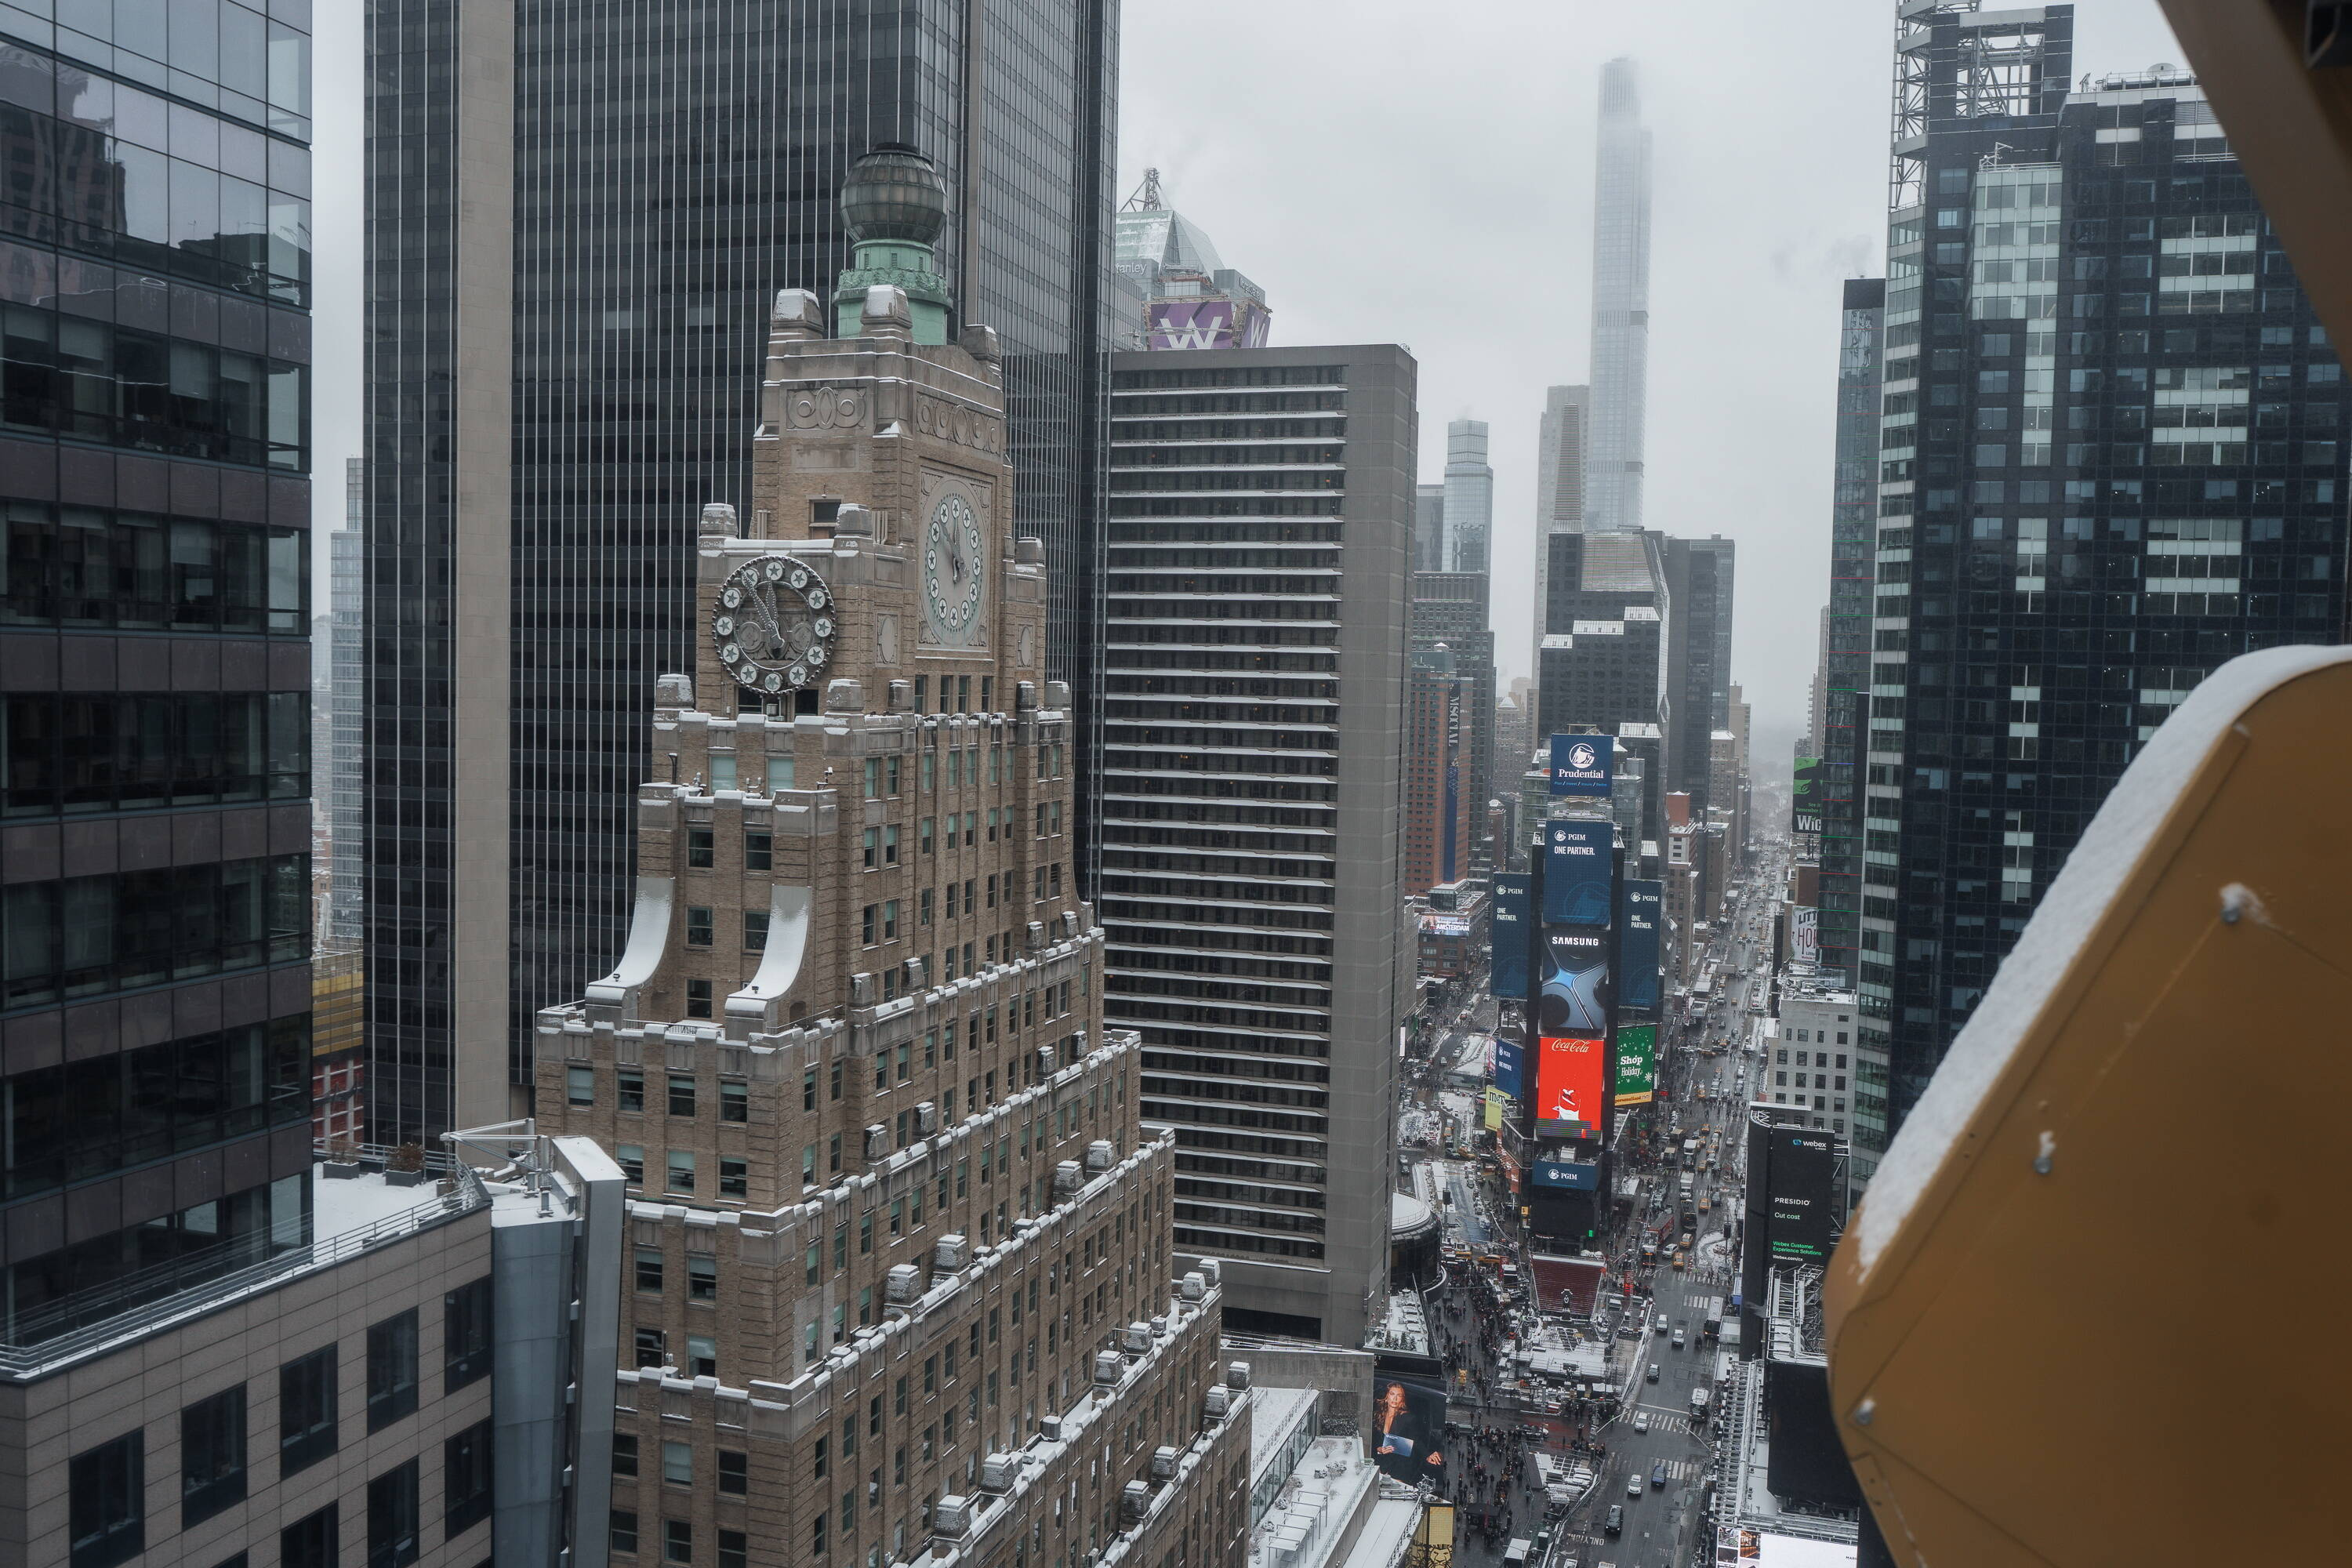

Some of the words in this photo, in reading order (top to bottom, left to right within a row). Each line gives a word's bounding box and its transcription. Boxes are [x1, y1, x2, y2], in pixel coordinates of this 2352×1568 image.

[1558, 768, 1604, 779] Prudential
[1554, 846, 1566, 855] ONE
[1567, 847, 1595, 855] PARTNER.
[1552, 936, 1599, 946] SAMSUNG
[1552, 1038, 1592, 1053] Coca-Cola
[1620, 1055, 1643, 1066] Shop
[1560, 1172, 1578, 1181] PGIM
[1774, 1197, 1810, 1206] PRESIDIO
